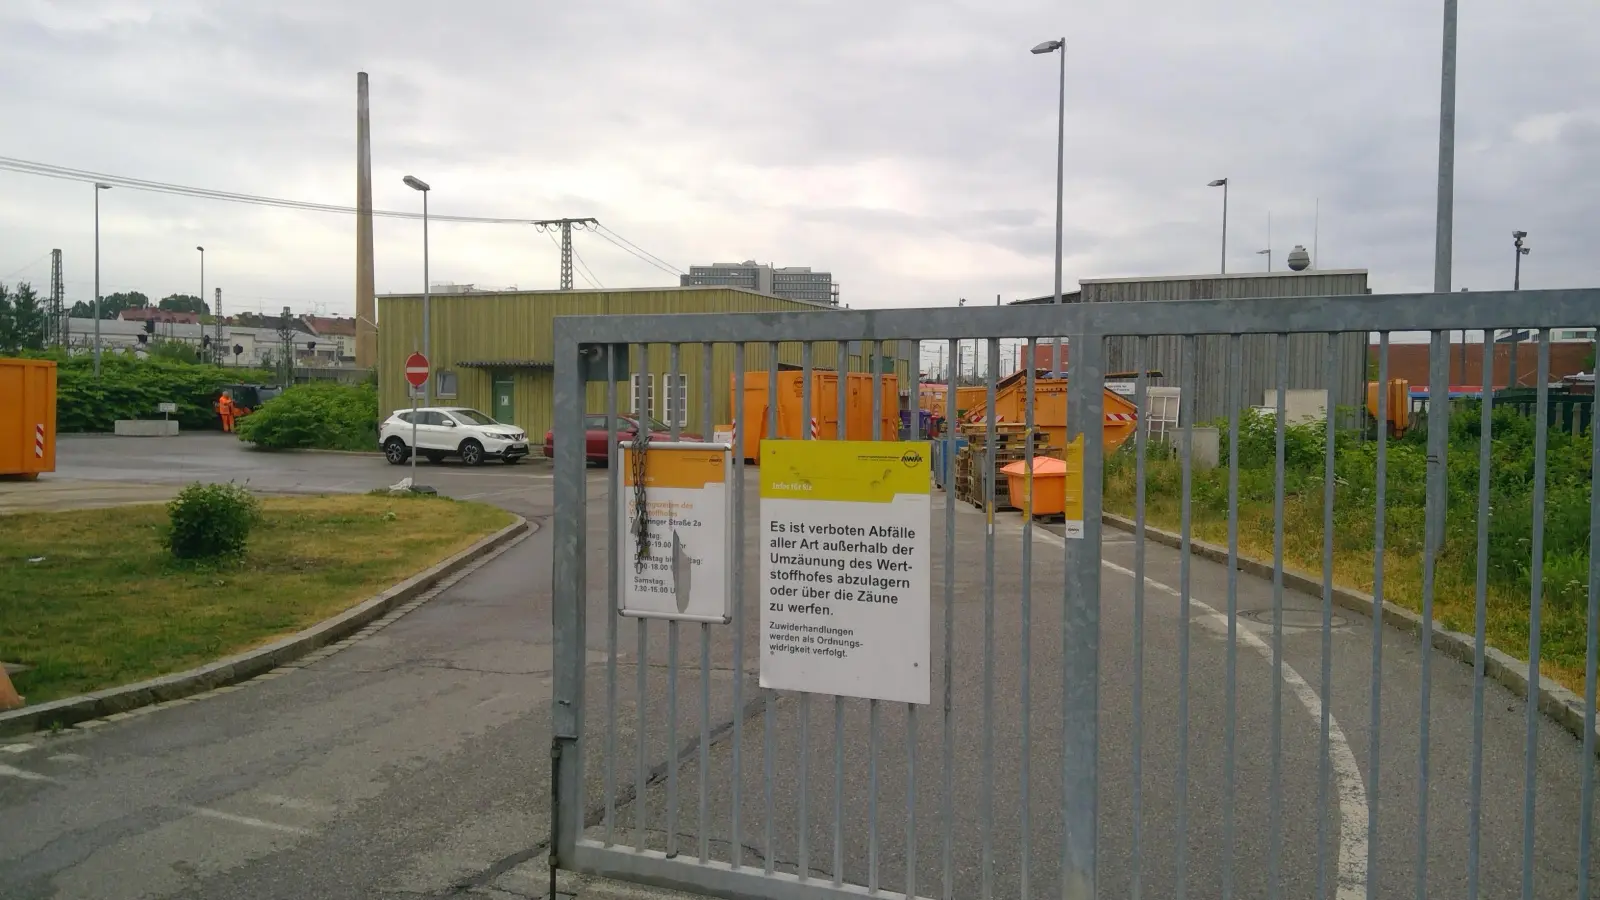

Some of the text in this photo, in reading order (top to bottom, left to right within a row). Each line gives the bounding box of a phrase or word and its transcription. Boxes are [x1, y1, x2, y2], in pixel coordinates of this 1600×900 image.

[669, 518, 691, 526] Straße
[770, 521, 916, 538] Es ist verboten Abfälle
[770, 538, 914, 555] aller Art außerhalb der
[770, 553, 912, 572] Umzäunung des Wert-
[634, 576, 665, 586] Samstag:
[770, 570, 910, 589] stoffhofes abzulagern
[634, 585, 668, 594] 7.30-15.00
[770, 586, 898, 604] oder über die Zäune
[770, 602, 834, 616] zu werfen.
[770, 622, 854, 636] Zuwiderhandlungen
[770, 633, 864, 648] werden als Ordnungs-
[770, 643, 848, 658] widrigkeit verfolgt.
